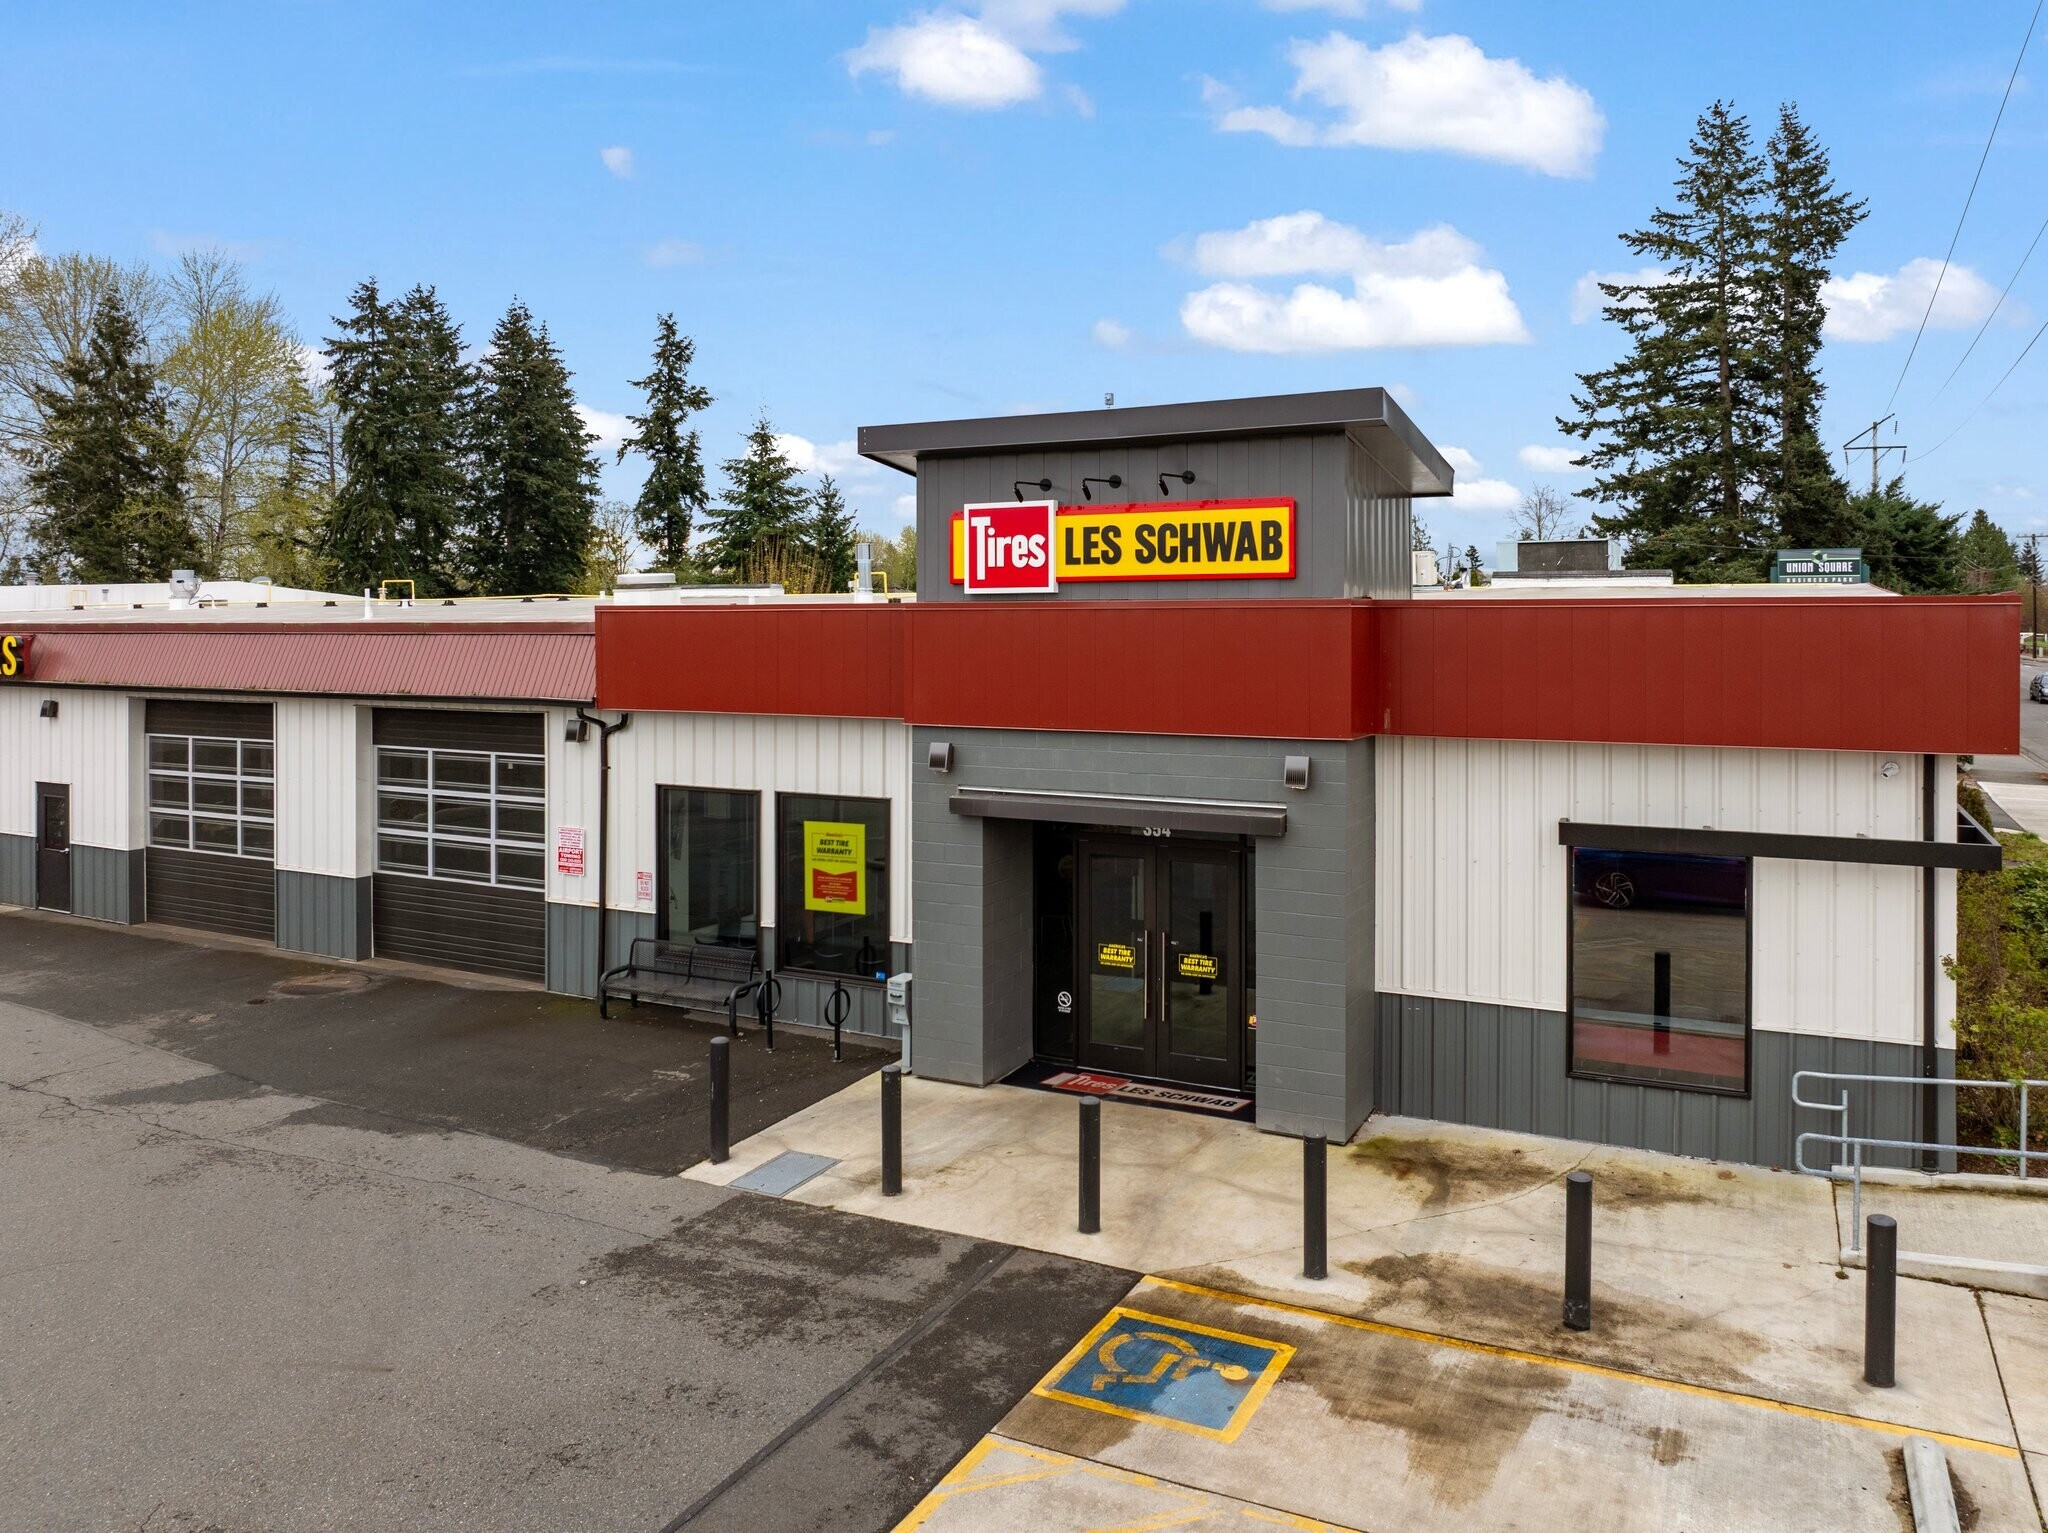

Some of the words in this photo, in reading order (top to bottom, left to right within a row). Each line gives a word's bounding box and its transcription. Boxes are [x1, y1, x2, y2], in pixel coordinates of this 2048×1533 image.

[971, 516, 1046, 580] Tires
[1065, 525, 1122, 565] LES
[1135, 520, 1283, 564] SCHWAB
[1786, 562, 1814, 573] UNION
[1818, 561, 1853, 573] SQUARE
[819, 838, 835, 846] BEST
[836, 839, 849, 847] TIRE
[816, 847, 853, 855] WARRANTY
[1100, 953, 1134, 963] WARRANTY
[1183, 957, 1198, 965] BEST
[1199, 959, 1213, 967] TIRE
[1180, 963, 1216, 974] WARRANTY
[1067, 1074, 1118, 1090] Tires
[1118, 1085, 1153, 1095] LES
[1154, 1091, 1239, 1107] SCHWAB
